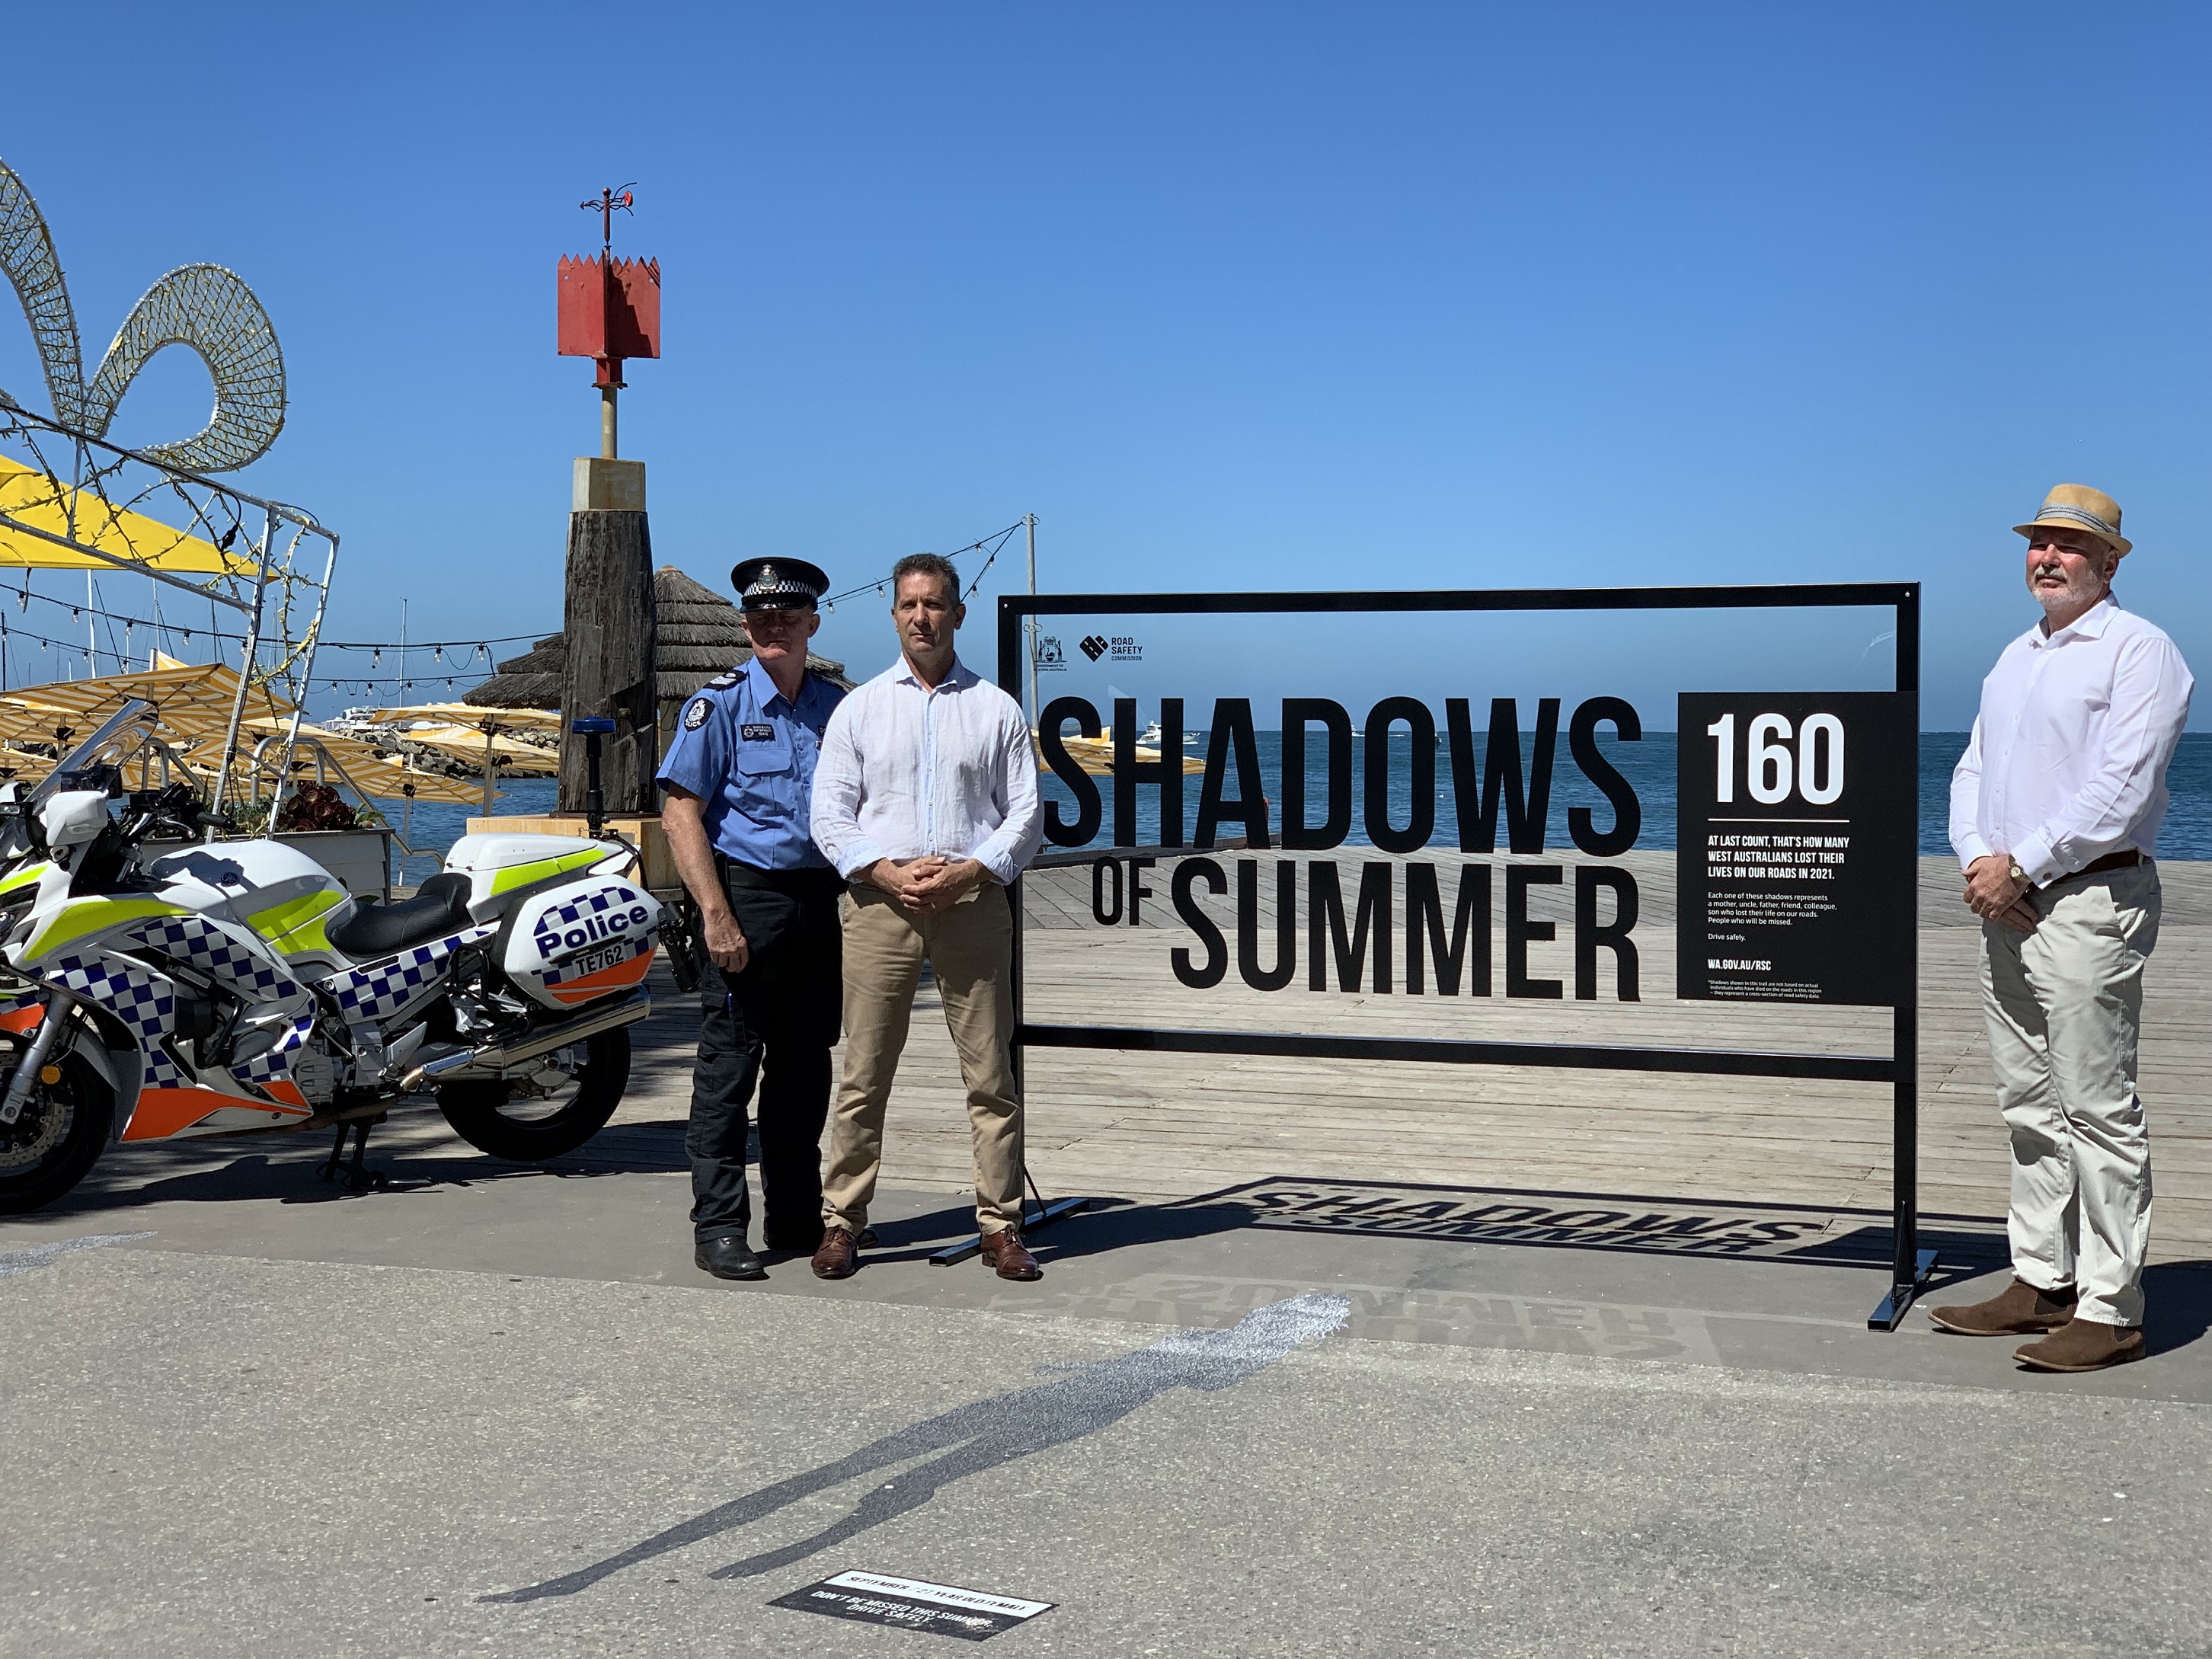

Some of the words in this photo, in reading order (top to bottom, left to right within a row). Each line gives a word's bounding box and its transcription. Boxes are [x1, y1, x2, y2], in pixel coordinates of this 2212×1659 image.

[1111, 637, 1133, 646] ROAD
[1111, 646, 1143, 654] SAFETY
[1708, 713, 1844, 805] 160
[1038, 696, 1642, 857] SHADOWS
[1709, 835, 1718, 845] AT
[1720, 835, 1740, 846] LAST
[1742, 836, 1771, 848] COUNT,
[1772, 836, 1801, 847] THAT'S
[1803, 836, 1823, 848] HOW
[1824, 837, 1849, 848] MANY
[1708, 851, 1731, 862] WEST
[1734, 852, 1792, 863] AUSTRALIANS
[1795, 852, 1816, 864] LOST
[1819, 853, 1845, 864] THEIR
[1708, 866, 1732, 877] LIVES
[1734, 867, 1747, 877] ON
[1748, 867, 1766, 878] OUR
[1768, 867, 1797, 879] ROADS
[1798, 868, 1808, 879] IN
[1810, 868, 1835, 879] 2021.
[1794, 893, 1828, 902] represents
[1708, 917, 1730, 925] People
[536, 906, 648, 959] Police
[1092, 856, 1156, 925] OF
[1171, 857, 1641, 1002] SUMMER
[1726, 934, 1746, 942] safely.
[576, 945, 624, 975] TE762
[1708, 959, 1772, 970] WA.GOV.AU/RSC
[847, 1576, 909, 1590] SEPTEMBER
[934, 1590, 962, 1600] YEAR
[984, 1600, 1029, 1611] FEMALE
[810, 1590, 852, 1602] DON'T
[864, 1599, 912, 1612] MISSED
[910, 1606, 940, 1617] THIS
[846, 1603, 887, 1615] DRIVE
